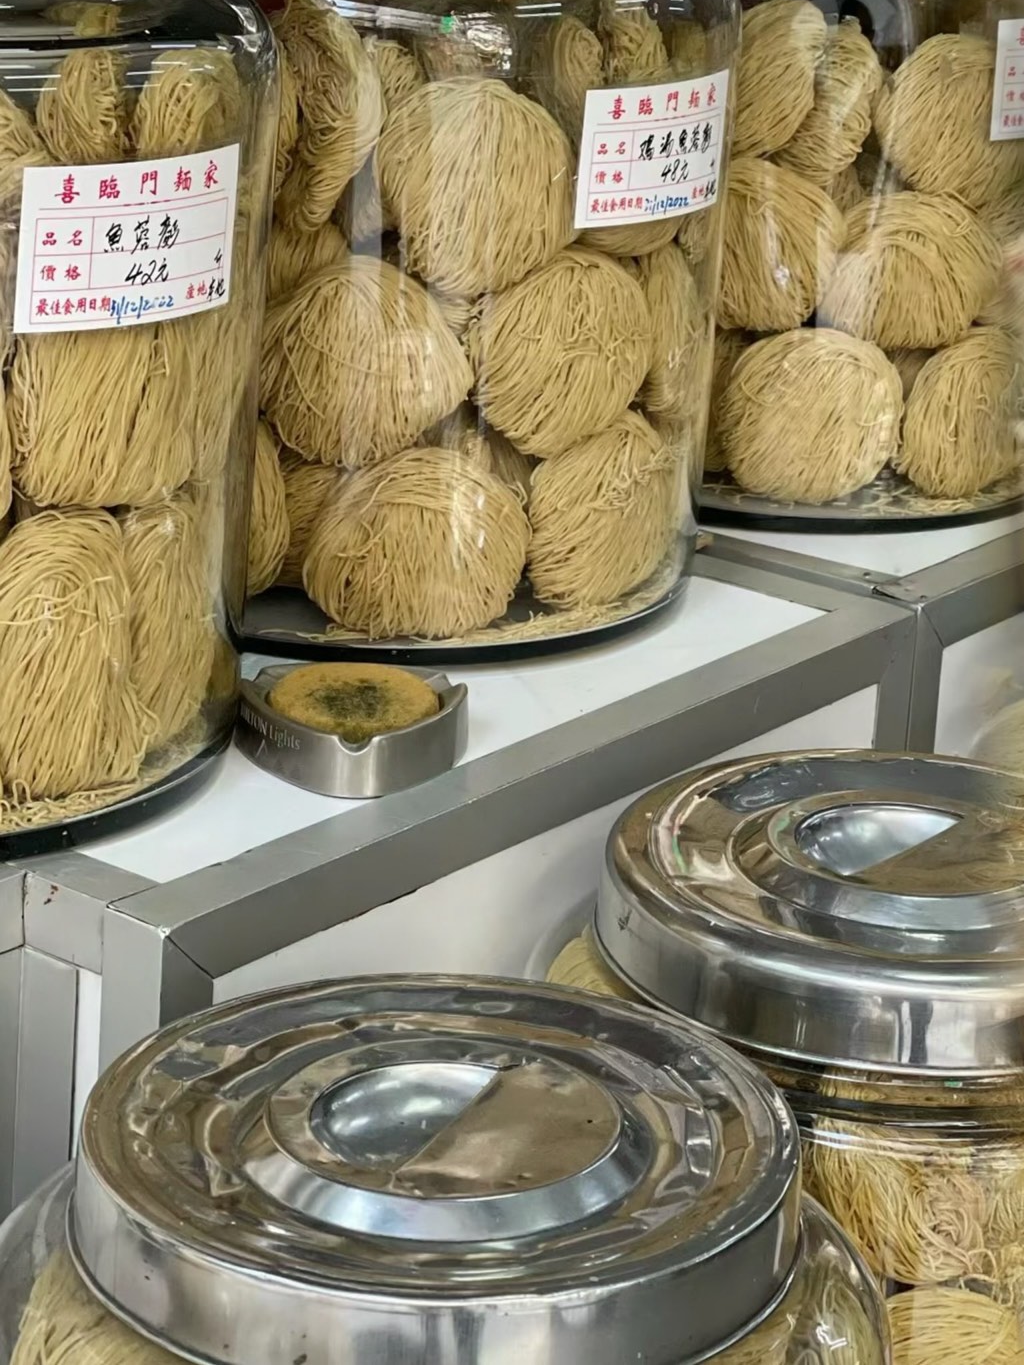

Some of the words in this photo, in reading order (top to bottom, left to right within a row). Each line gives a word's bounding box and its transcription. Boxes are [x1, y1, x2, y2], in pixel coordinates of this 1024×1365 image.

[55, 160, 219, 204] 喜臨門麵家
[42, 230, 84, 246] 品名
[39, 264, 82, 281] 價格
[269, 724, 300, 750] Lights
